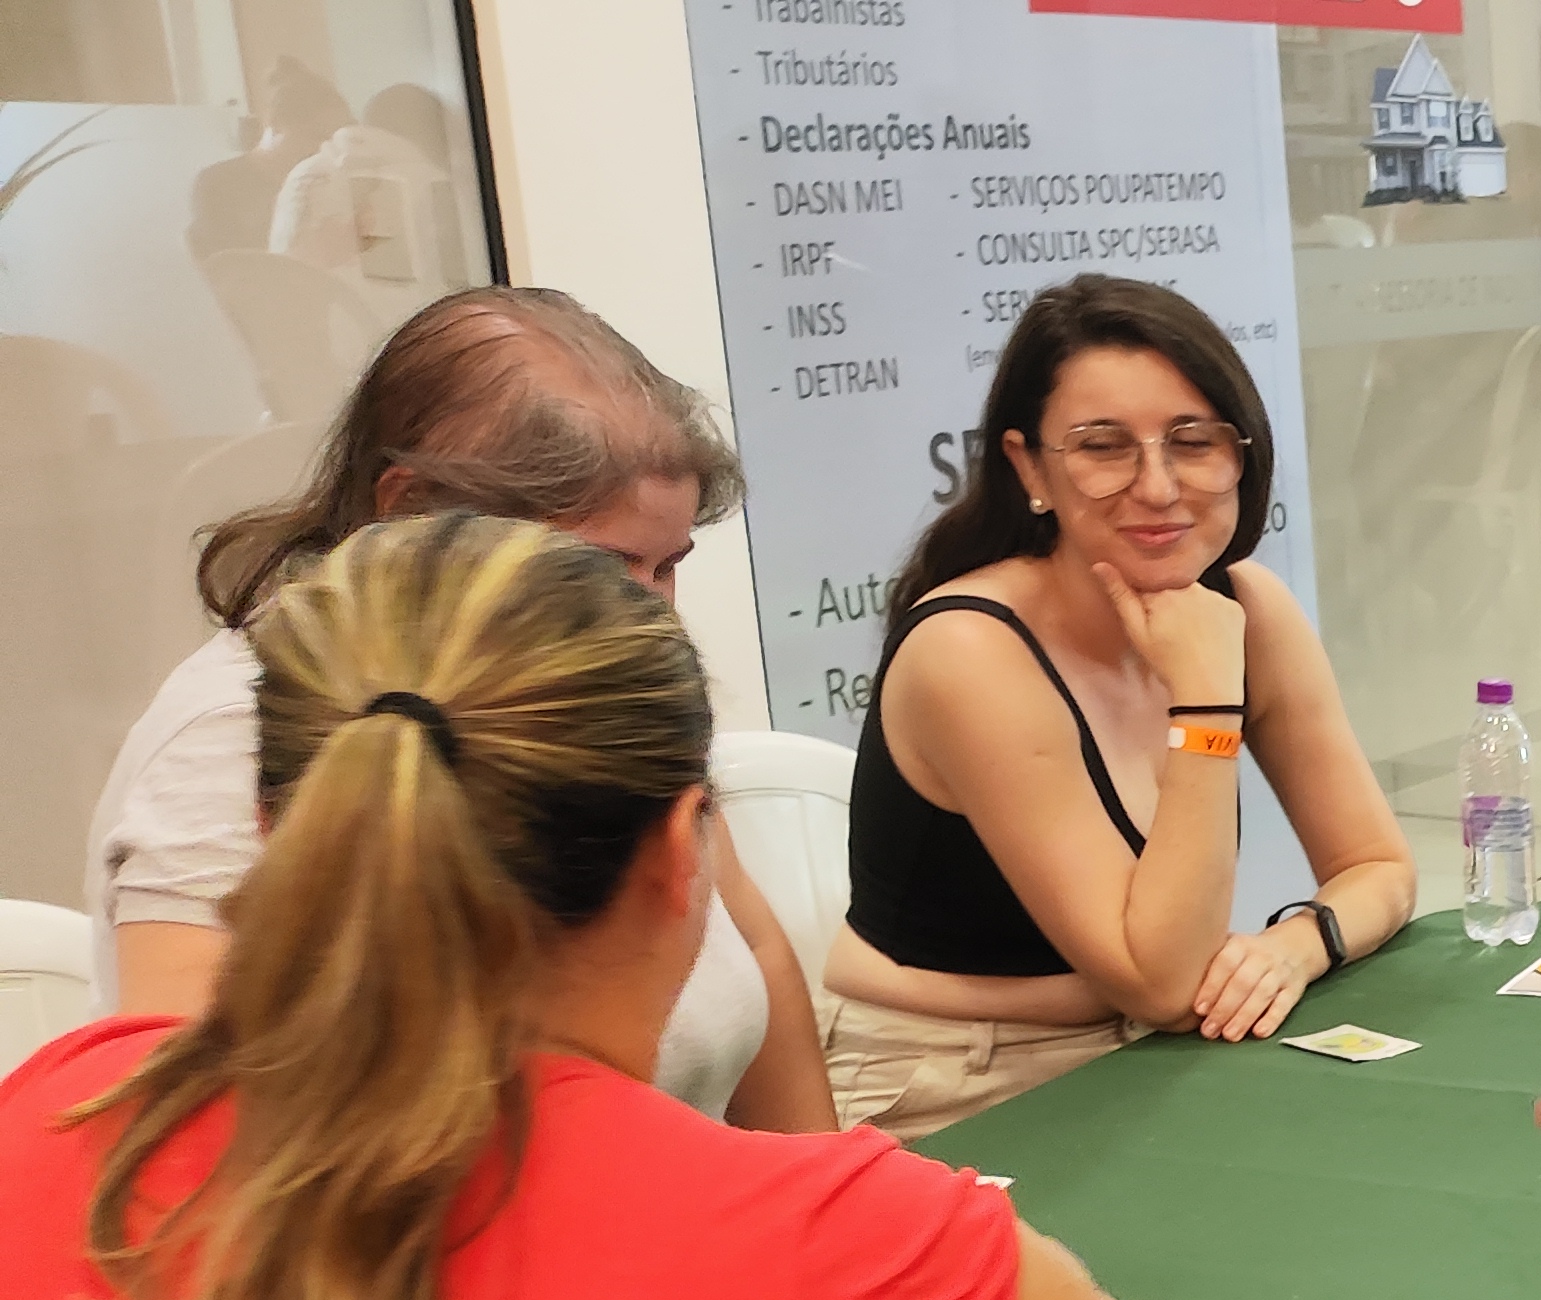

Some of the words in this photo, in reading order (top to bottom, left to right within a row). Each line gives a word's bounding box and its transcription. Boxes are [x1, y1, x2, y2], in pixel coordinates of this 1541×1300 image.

[754, 50, 898, 86] Tributários
[760, 113, 934, 161] Declarações
[942, 113, 1031, 150] Anuais
[773, 180, 847, 216] DASN
[854, 178, 903, 213] MEI
[970, 173, 1080, 214] SERVIÇOS
[1084, 171, 1226, 204] POUPATEMPO
[780, 240, 836, 277] IRPF
[976, 229, 1094, 265] CONSULTA
[1097, 224, 1221, 262] SPC/SERASA
[786, 301, 847, 338] INSS
[794, 357, 899, 400] DETRAN
